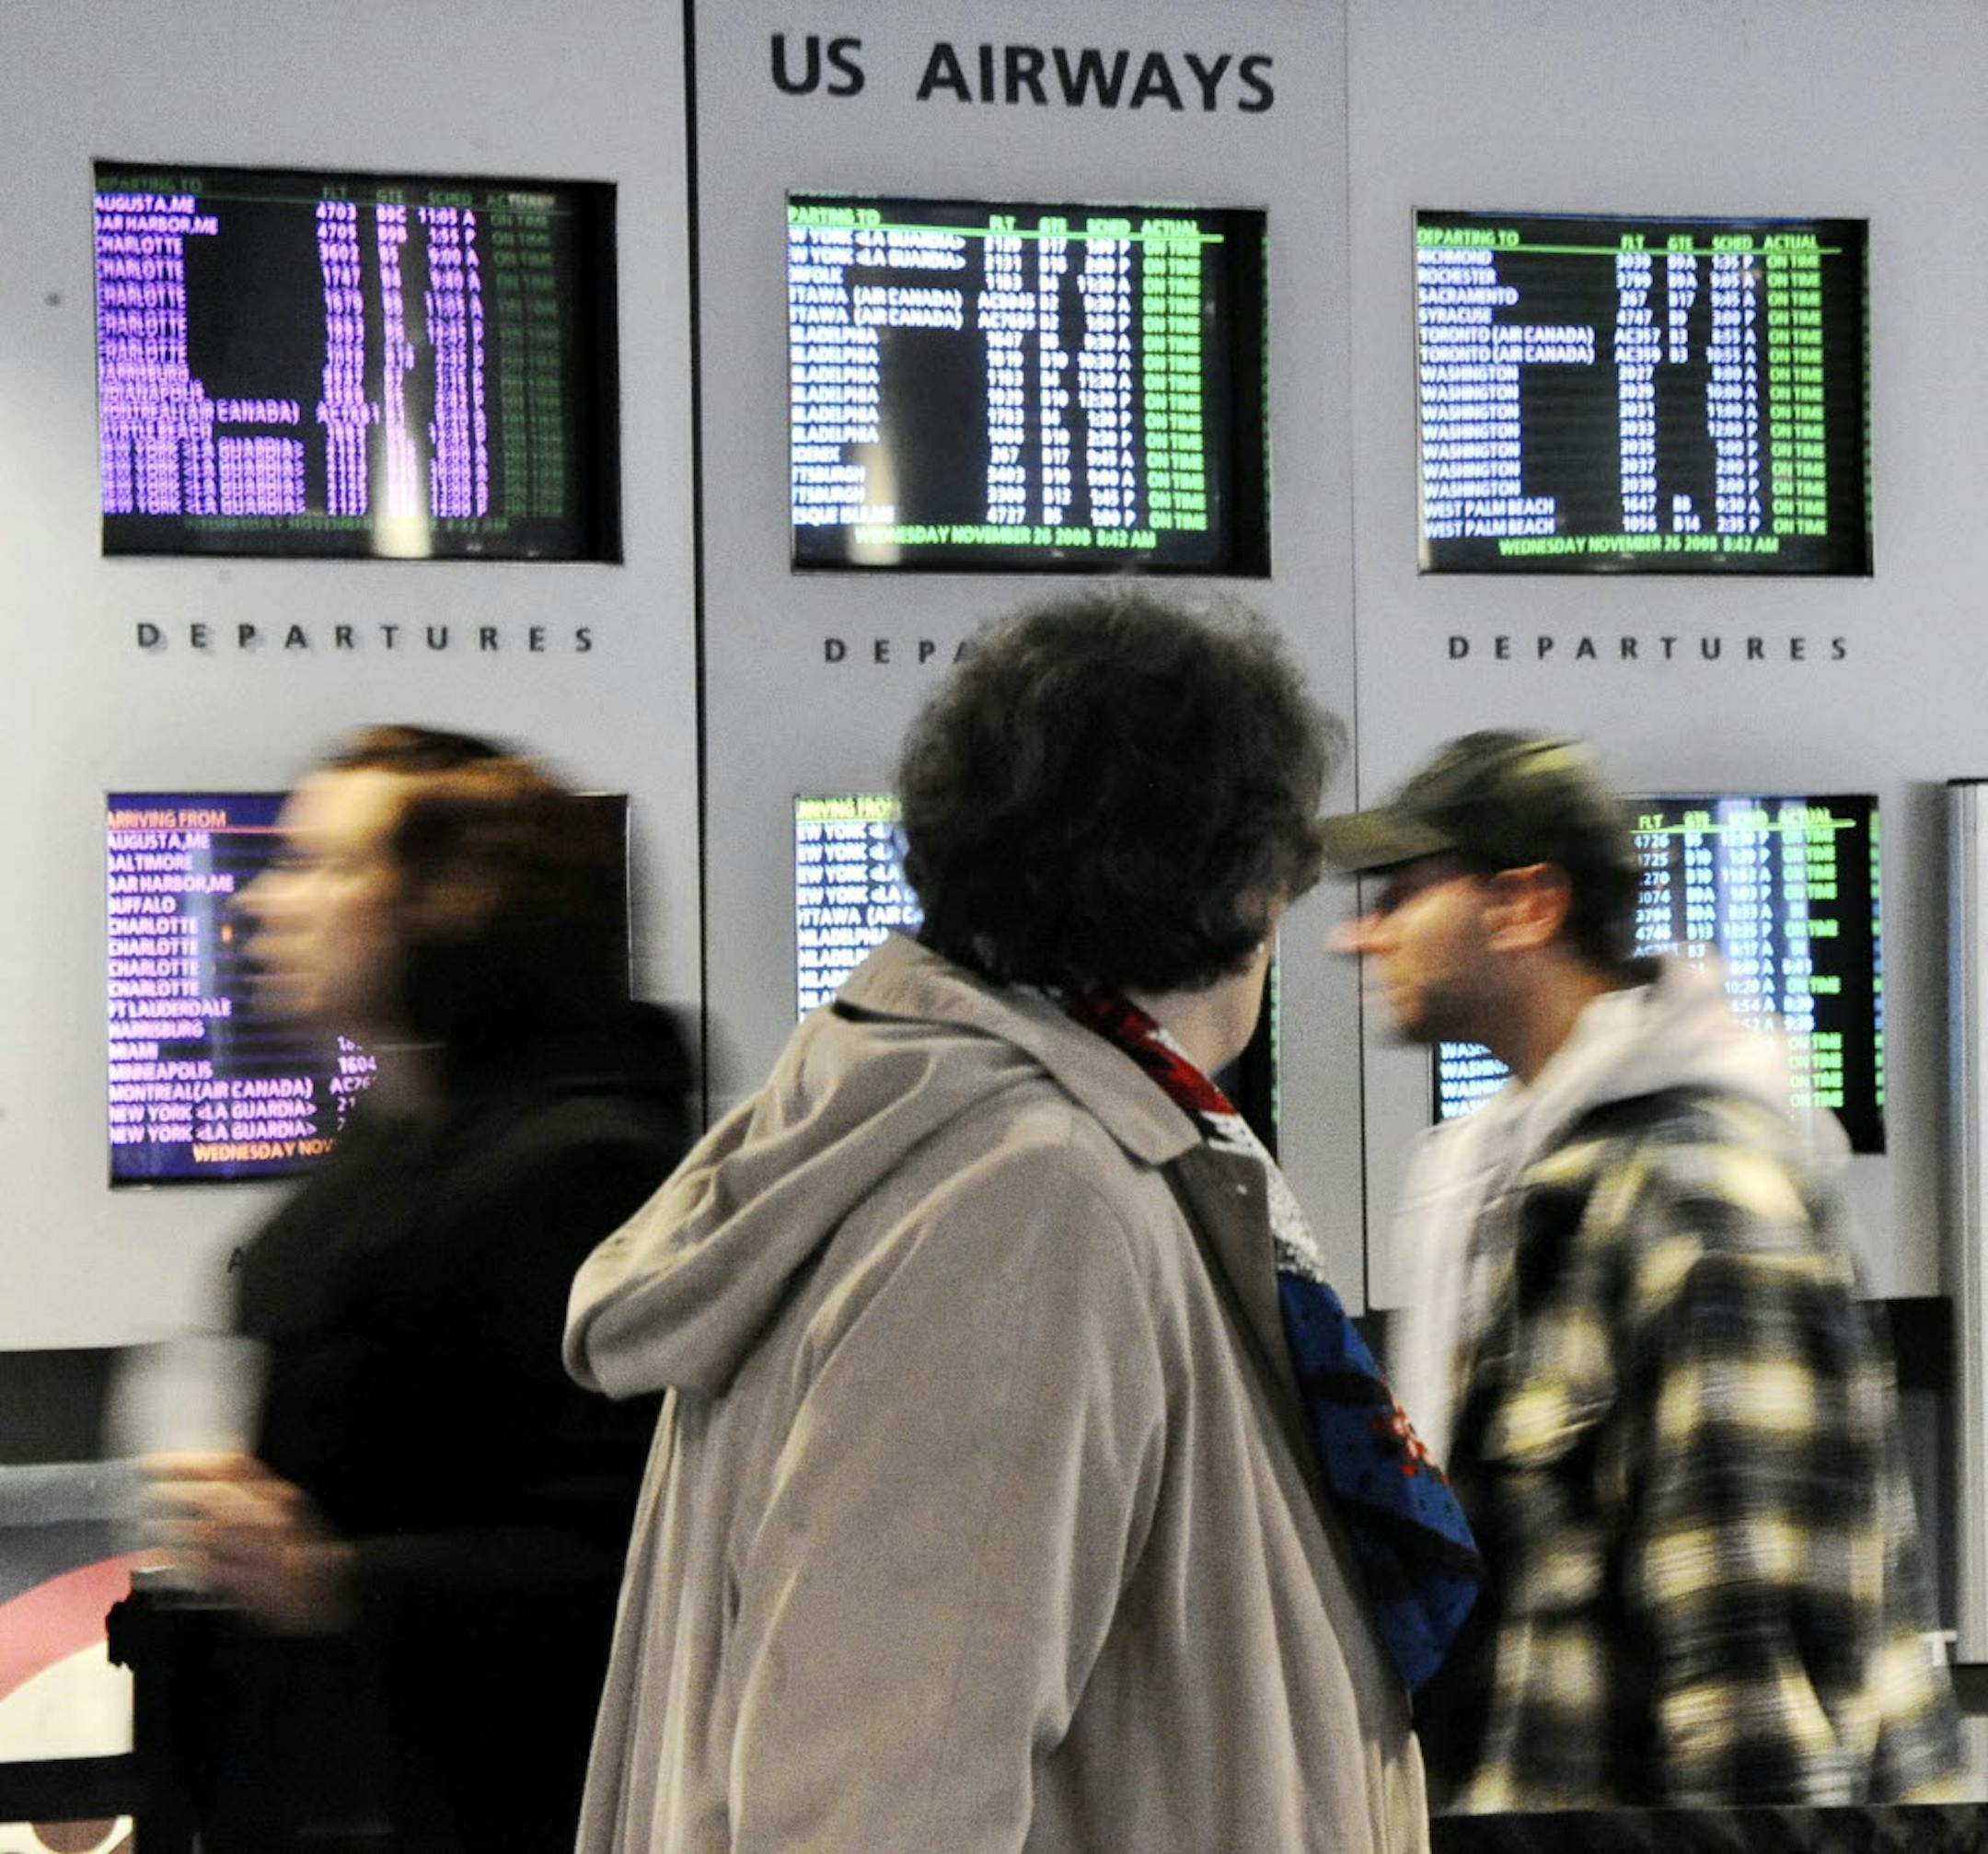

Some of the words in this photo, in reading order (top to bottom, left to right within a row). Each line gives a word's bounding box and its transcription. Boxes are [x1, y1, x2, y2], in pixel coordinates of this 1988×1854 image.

[771, 33, 865, 97] US
[916, 42, 1275, 112] AIRWAYS
[316, 202, 357, 221] 4703
[418, 207, 457, 226] 11:05
[463, 209, 476, 226] A
[1141, 220, 1197, 235] ACTUAL
[1416, 228, 1496, 246] DEPARTING
[1499, 230, 1519, 246] TO
[1620, 234, 1646, 249] FLT
[1668, 235, 1693, 250] GTE
[1712, 235, 1753, 250] SCHED
[1764, 235, 1819, 250] ACTUAL
[1742, 254, 1754, 271] P
[1766, 254, 1788, 270] ON
[1791, 254, 1820, 270] TIME
[1742, 272, 1756, 289] A
[1766, 272, 1788, 288] ON
[1791, 272, 1820, 288] TIME
[1418, 286, 1519, 305] SACRAMENTO
[1742, 291, 1756, 308] A
[1419, 307, 1493, 324] SYRACUSE
[1744, 309, 1756, 326] P
[1420, 325, 1491, 343] TORONTO
[1524, 325, 1595, 343] CANADA)
[1744, 329, 1757, 345] A
[1420, 344, 1492, 362] TORONTO
[1524, 344, 1595, 365] CANADA)
[1744, 346, 1758, 364] A
[1421, 364, 1520, 383] WASHINGTON
[1744, 365, 1758, 383] A
[1421, 383, 1520, 402] WASHINGTON
[1745, 383, 1759, 400] A
[1422, 402, 1520, 422] WASHINGTON
[1746, 401, 1759, 420] A
[1423, 422, 1520, 442] WASHINGTON
[1747, 421, 1759, 438] P
[1424, 441, 1520, 460] WASHINGTON
[1747, 439, 1759, 458] P
[1424, 459, 1521, 480] WASHINGTON
[1748, 458, 1760, 476] P
[1425, 479, 1521, 499] WASHINGTON
[1748, 477, 1760, 495] P
[1426, 500, 1463, 519] WEST
[1464, 498, 1506, 517] PALM
[1508, 497, 1555, 516] BEACH
[1748, 496, 1762, 515] A
[1772, 499, 1793, 516] ON
[1796, 499, 1827, 516] TIME
[854, 526, 950, 545] WEDNESDAY
[952, 525, 1032, 544] NOVEMBER
[1034, 527, 1052, 544] 26
[1056, 527, 1092, 546] 2008
[1096, 529, 1128, 548] 8:42
[1130, 530, 1157, 549] AM
[1426, 519, 1464, 539] WEST
[1465, 518, 1507, 537] PALM
[1508, 516, 1555, 536] BEACH
[1749, 516, 1762, 534] P
[1773, 517, 1794, 534] ON
[1797, 517, 1828, 534] TIME
[1499, 536, 1587, 556] WEDNESDAY
[1588, 534, 1662, 554] NOVEMBER
[1664, 535, 1682, 552] 26
[1684, 534, 1718, 552] 2008
[1723, 534, 1752, 552] 8:42
[1754, 534, 1780, 552] AM
[136, 623, 593, 652] DEPARTURES
[1449, 636, 1846, 660] DEPARTURES
[178, 810, 227, 829] FROM
[1638, 813, 1664, 829] FLT
[129, 997, 232, 1018] LAUDERDALE
[231, 1077, 313, 1099] CANADA)
[109, 1104, 144, 1123] NEW
[147, 1103, 193, 1122] YORK
[231, 1098, 318, 1120] GUARDIA>
[109, 1124, 144, 1144] NEW
[147, 1123, 193, 1142] YORK
[231, 1118, 318, 1141] GUARDIA>
[193, 1141, 295, 1162] WEDNESDAY
